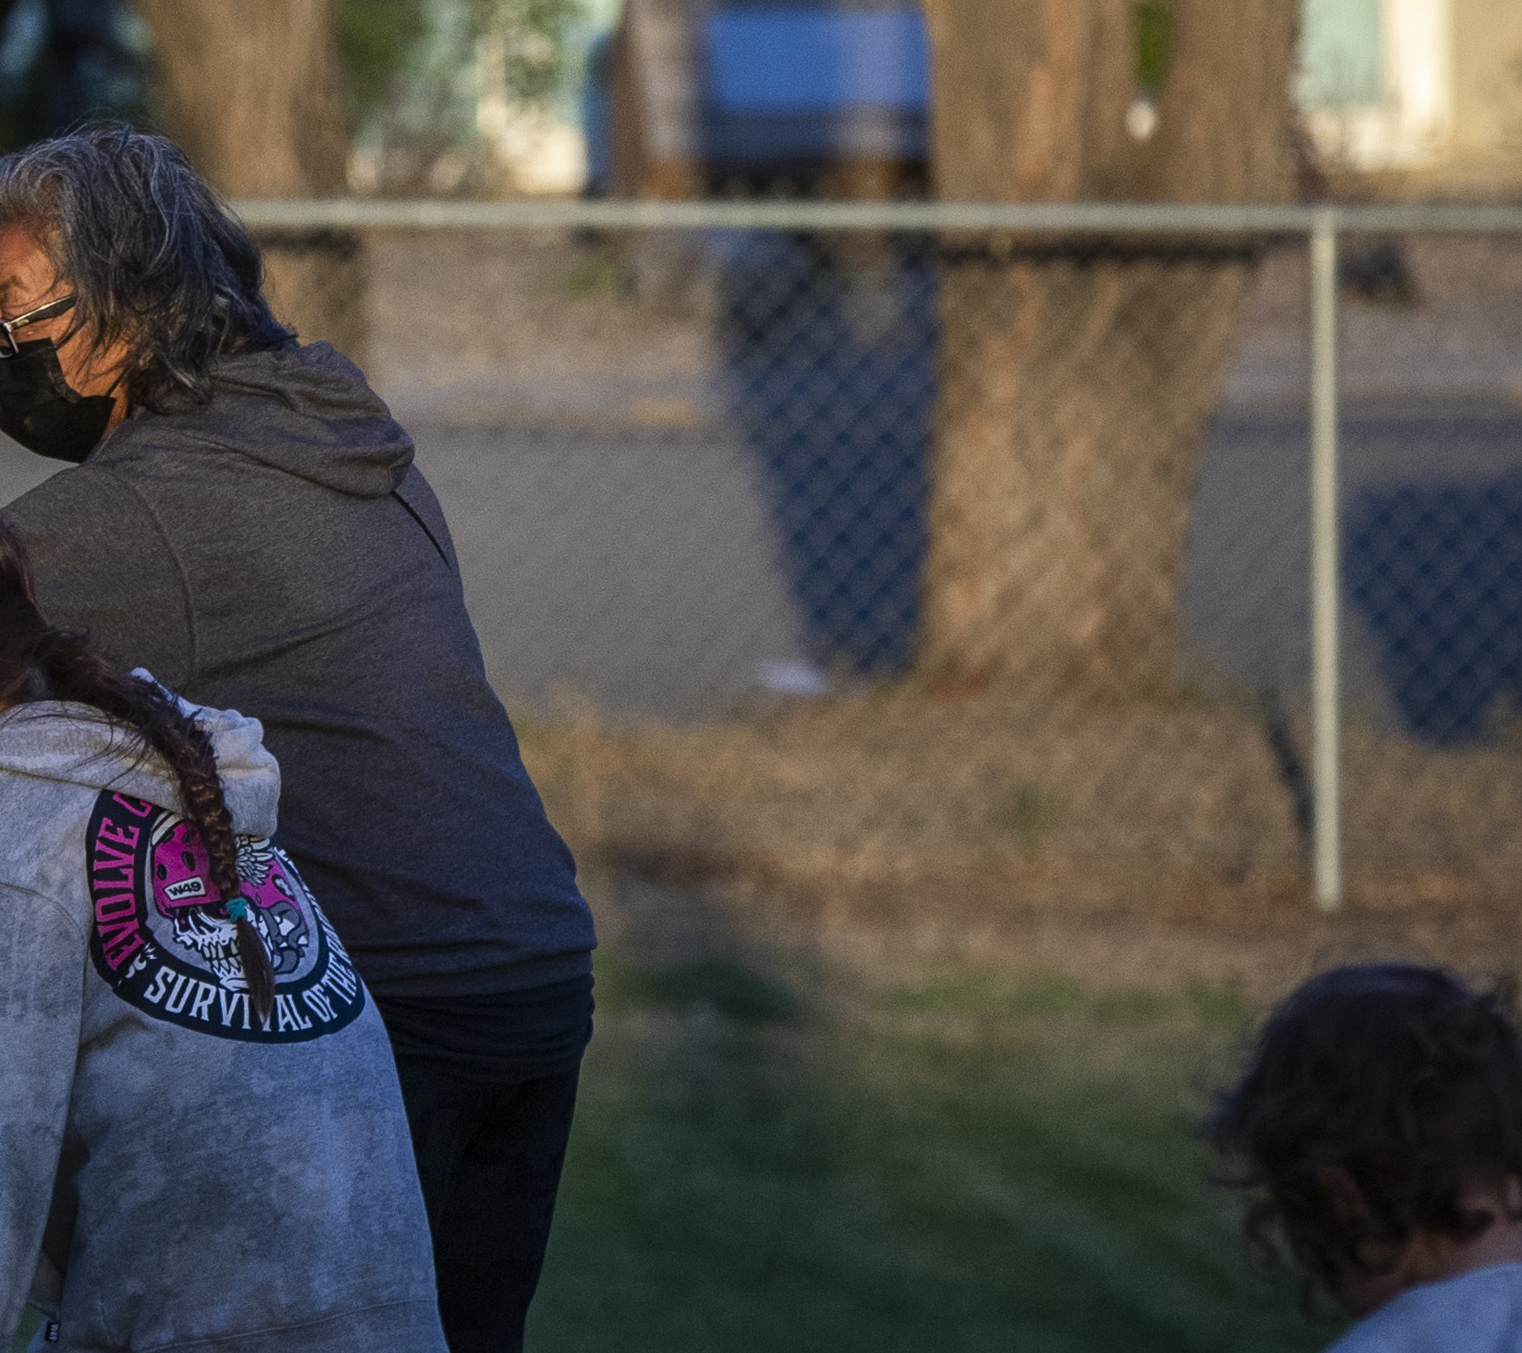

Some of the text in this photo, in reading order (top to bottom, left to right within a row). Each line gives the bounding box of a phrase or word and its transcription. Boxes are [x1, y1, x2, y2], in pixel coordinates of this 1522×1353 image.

[93, 817, 146, 971] EVOLVE
[168, 881, 202, 896] W49
[301, 983, 338, 1023] OF
[321, 953, 357, 1005] THE
